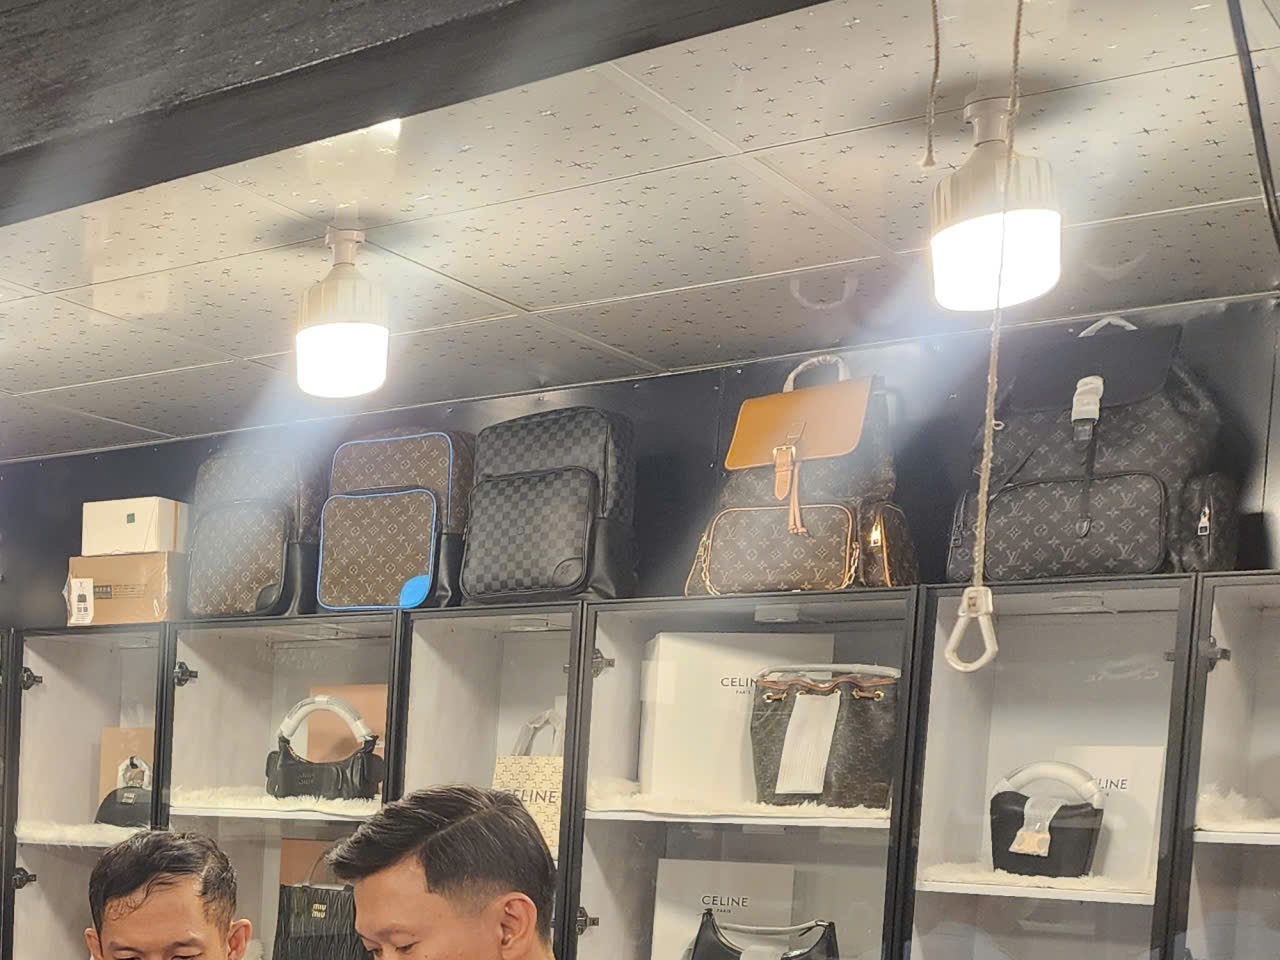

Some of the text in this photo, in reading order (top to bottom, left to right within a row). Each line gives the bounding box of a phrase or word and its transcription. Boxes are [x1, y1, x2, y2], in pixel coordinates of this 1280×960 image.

[721, 677, 758, 687] CELIN
[1098, 778, 1128, 790] LINE
[504, 789, 558, 804] ELINE
[702, 895, 749, 907] CELINE
